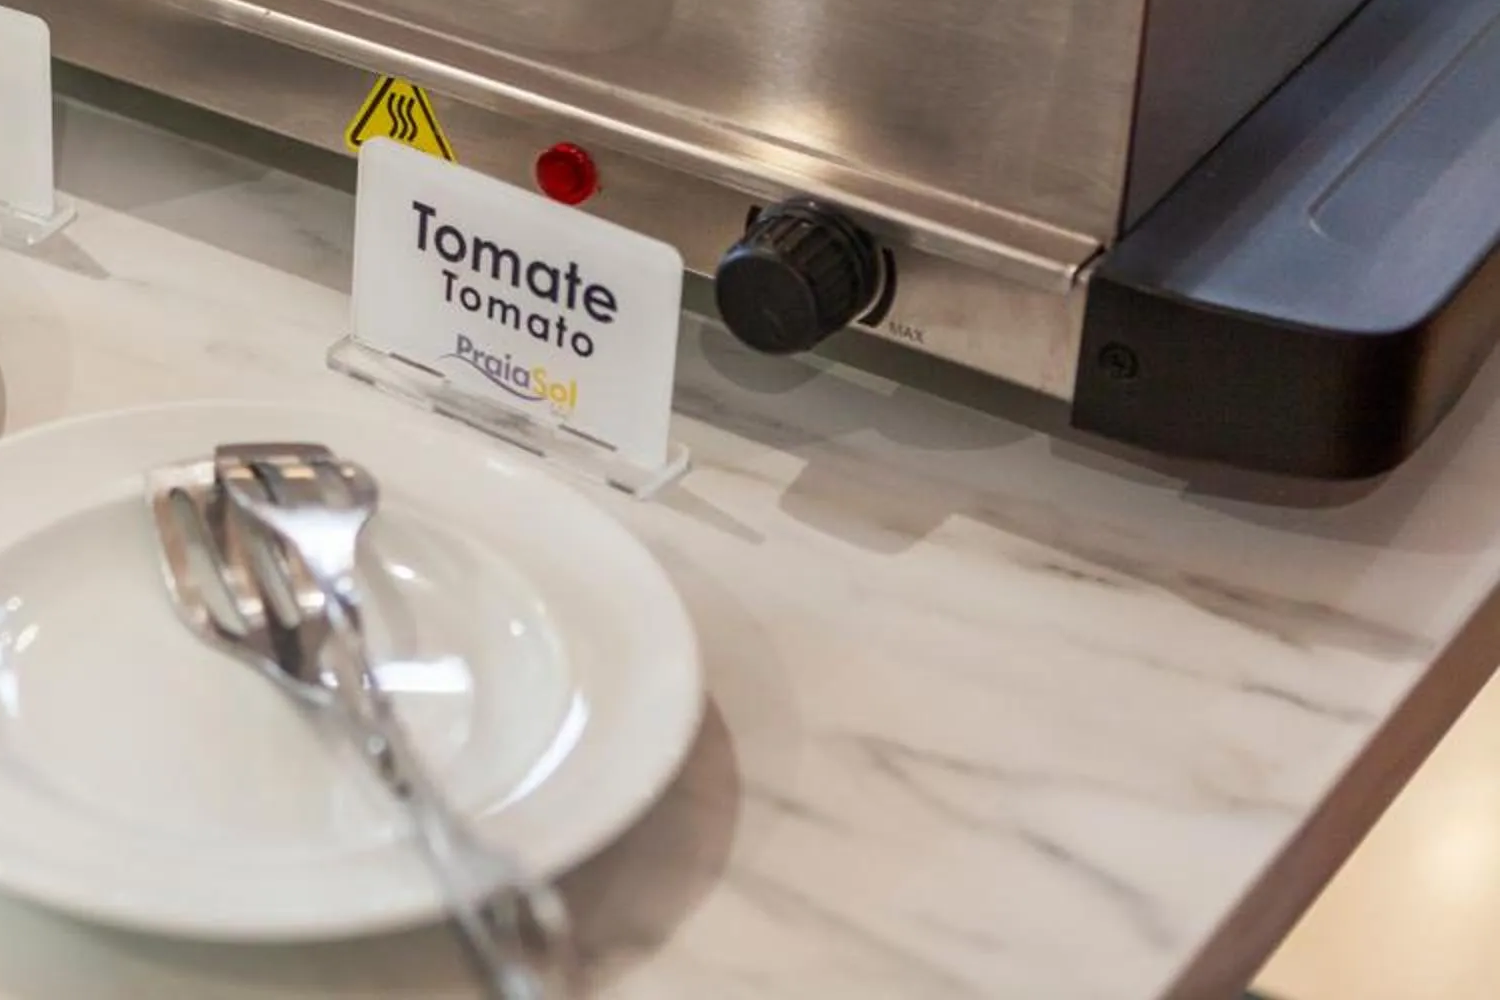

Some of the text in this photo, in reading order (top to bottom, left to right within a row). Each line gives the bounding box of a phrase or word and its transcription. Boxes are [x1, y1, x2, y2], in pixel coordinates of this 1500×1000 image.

[412, 200, 617, 324] Tomate
[441, 269, 595, 357] Tomato
[888, 321, 925, 345] MAX
[456, 334, 578, 409] PraiaSol
